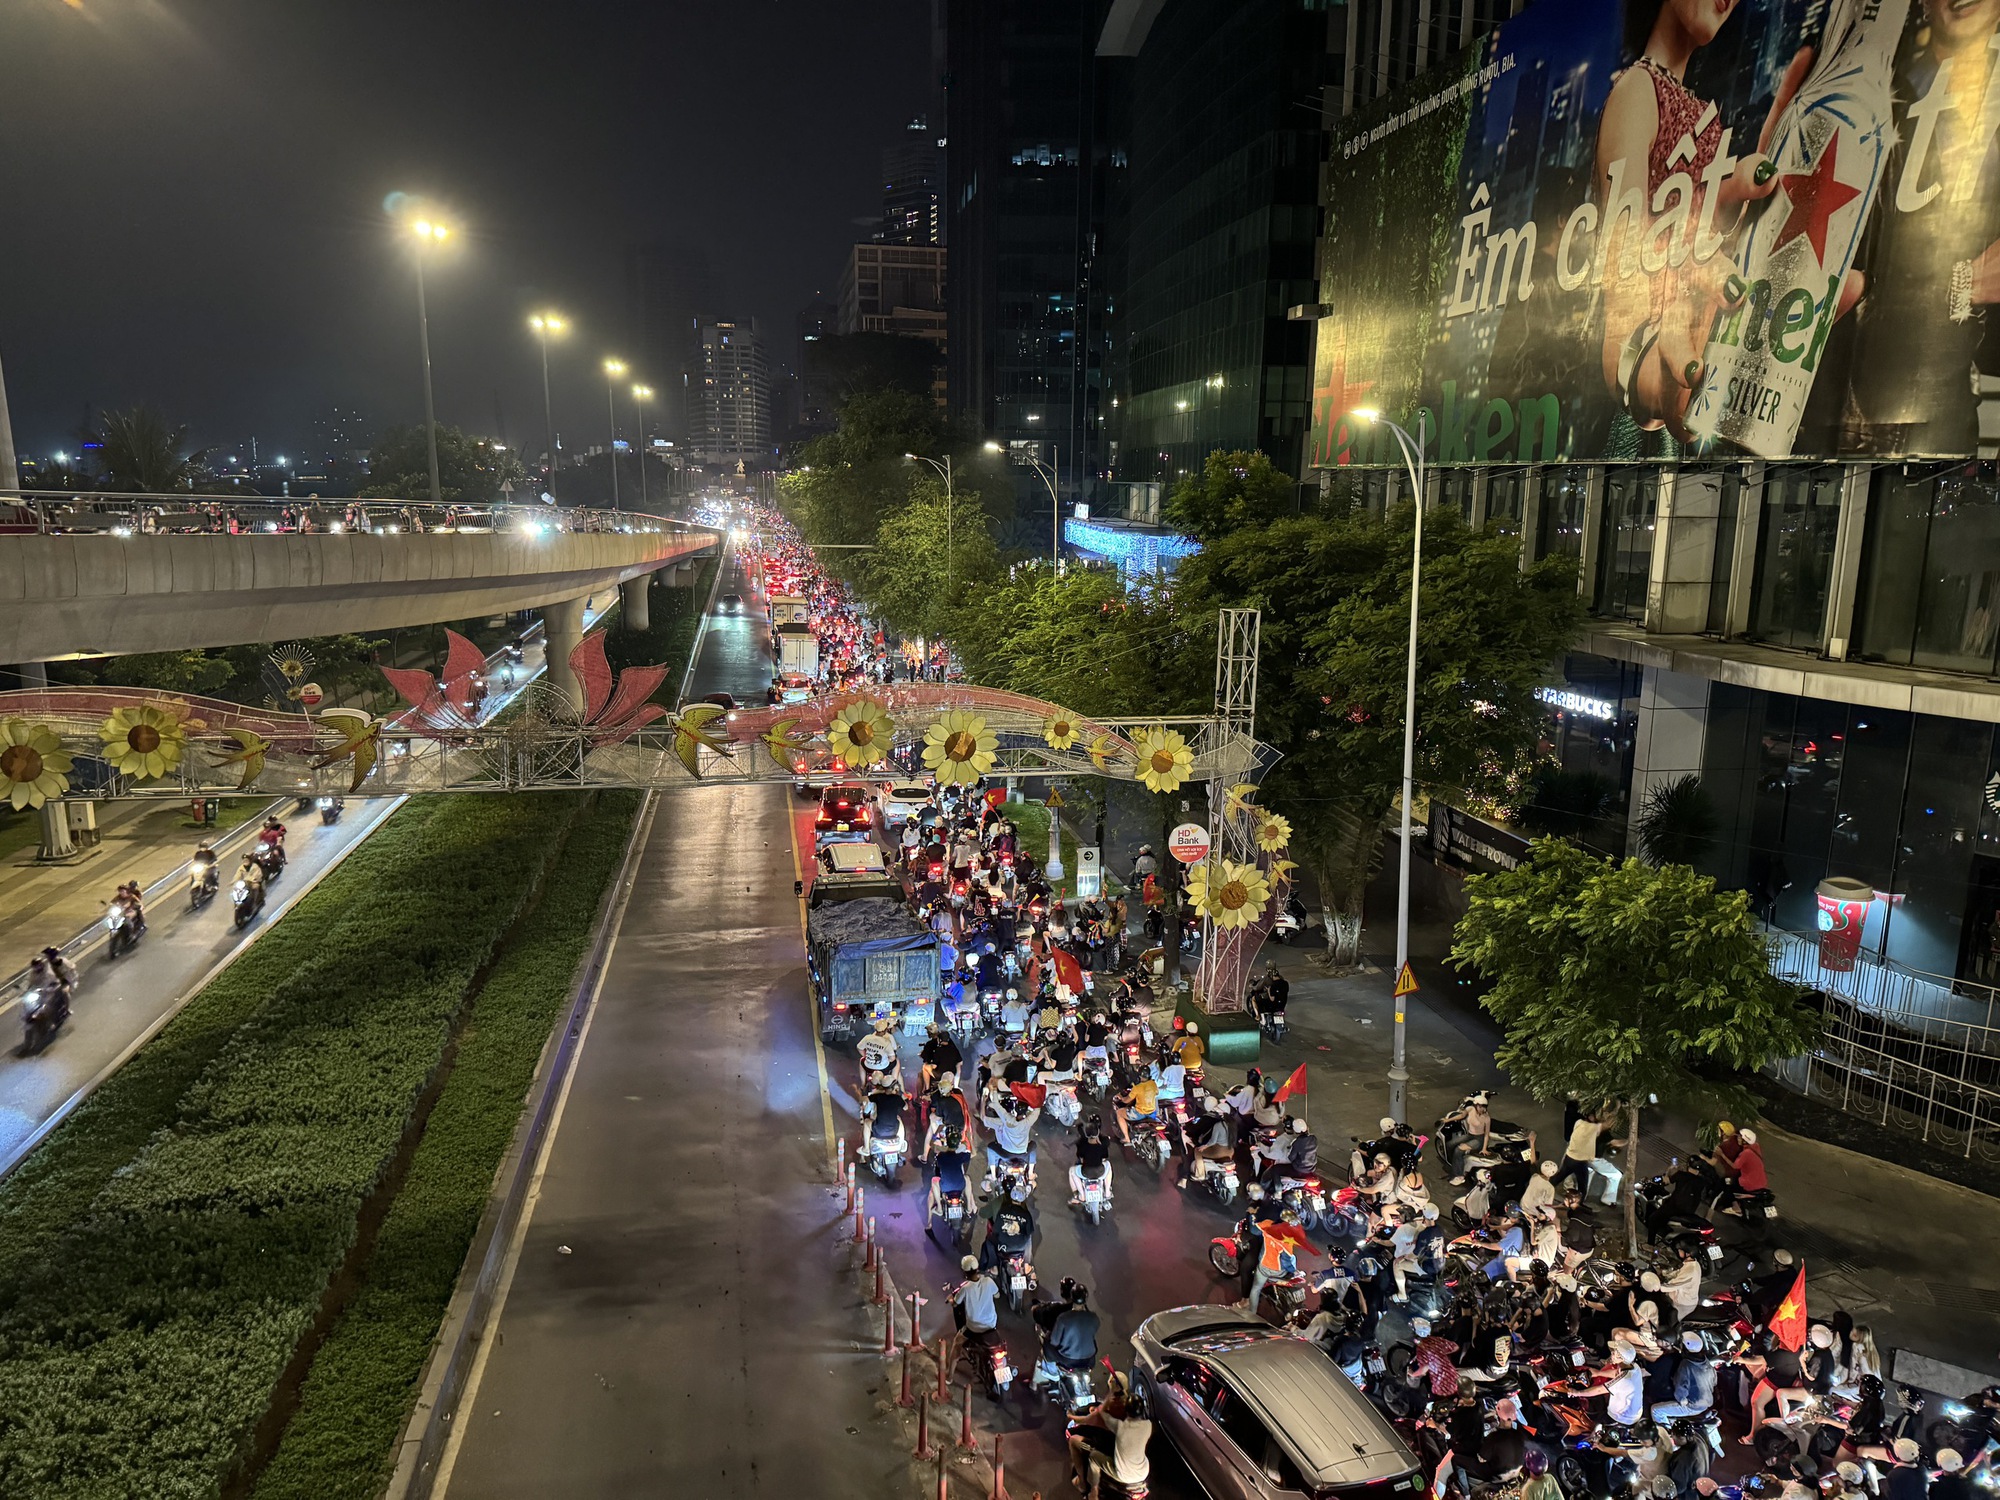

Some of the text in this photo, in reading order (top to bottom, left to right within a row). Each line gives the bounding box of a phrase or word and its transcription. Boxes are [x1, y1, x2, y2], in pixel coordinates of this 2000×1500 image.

[1400, 112, 1407, 128] 18
[1420, 93, 1441, 118] KHÔNG
[1479, 61, 1501, 87] RƯỢU,
[1502, 52, 1517, 74] BIA.
[1447, 183, 1536, 318] Êm
[1556, 100, 1740, 291] chất
[1722, 376, 1782, 425] SILVER
[1533, 686, 1612, 720] STARBUCKS
[1177, 829, 1191, 837] HD
[1177, 837, 1199, 845] Bank
[1450, 827, 1519, 872] WATERFRONT
